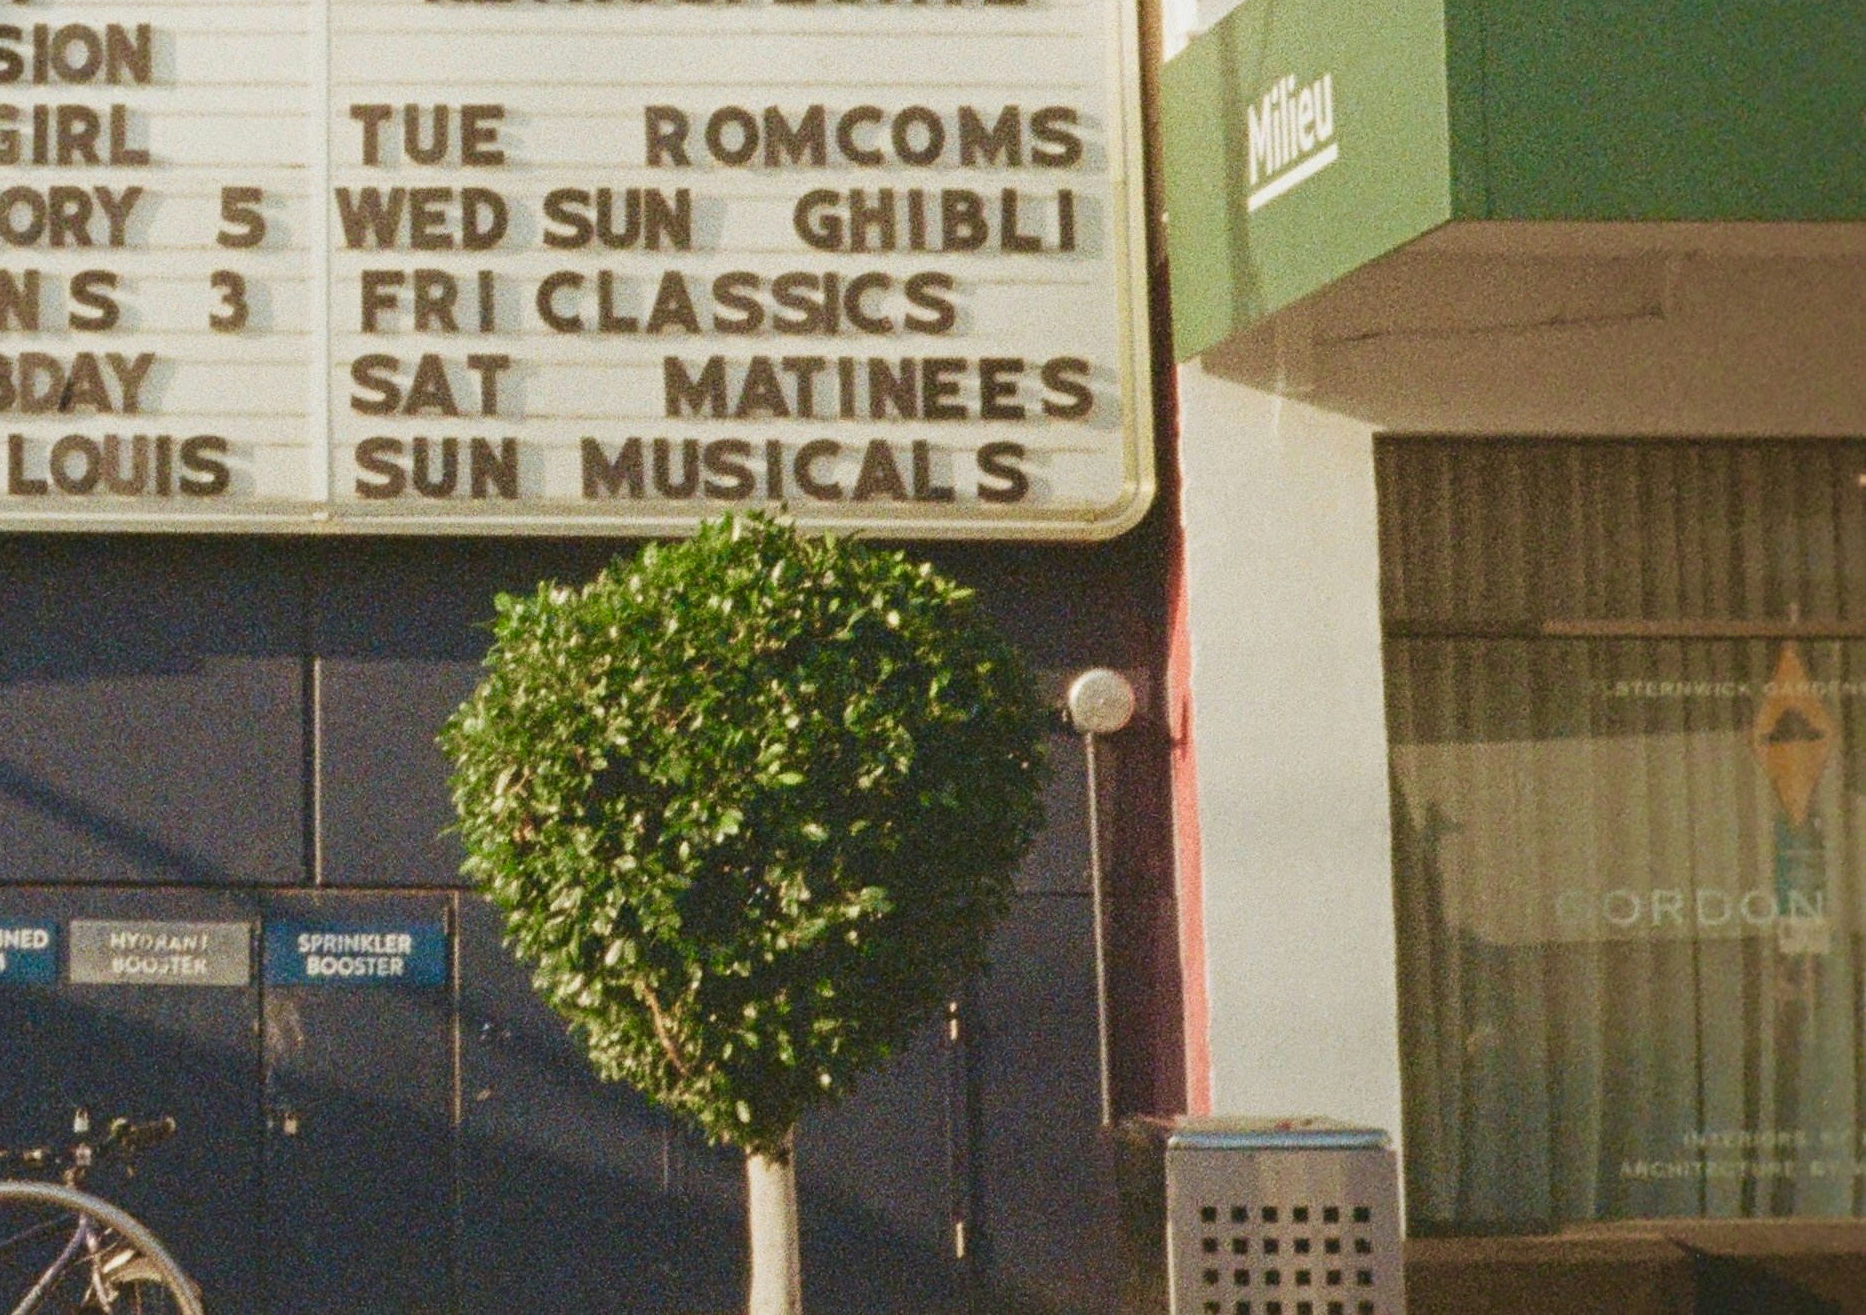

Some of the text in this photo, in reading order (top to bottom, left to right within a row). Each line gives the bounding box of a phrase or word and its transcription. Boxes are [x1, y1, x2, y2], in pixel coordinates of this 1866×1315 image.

[349, 103, 1083, 168] TUE ROMCOMS
[1247, 73, 1333, 185] Milieu
[216, 187, 267, 248] 5
[335, 187, 1076, 253] WED SUN GHIBLI
[209, 270, 250, 333] 3
[359, 269, 958, 335] FRI CLASSICS
[349, 353, 1094, 420] SAT MATINEES
[7, 433, 230, 497] LOUIS
[354, 436, 1030, 503] SUN MUSICALS
[1555, 887, 1824, 927] GORDON
[297, 932, 412, 954] SPRINKLER
[306, 955, 404, 976] BOOSTER
